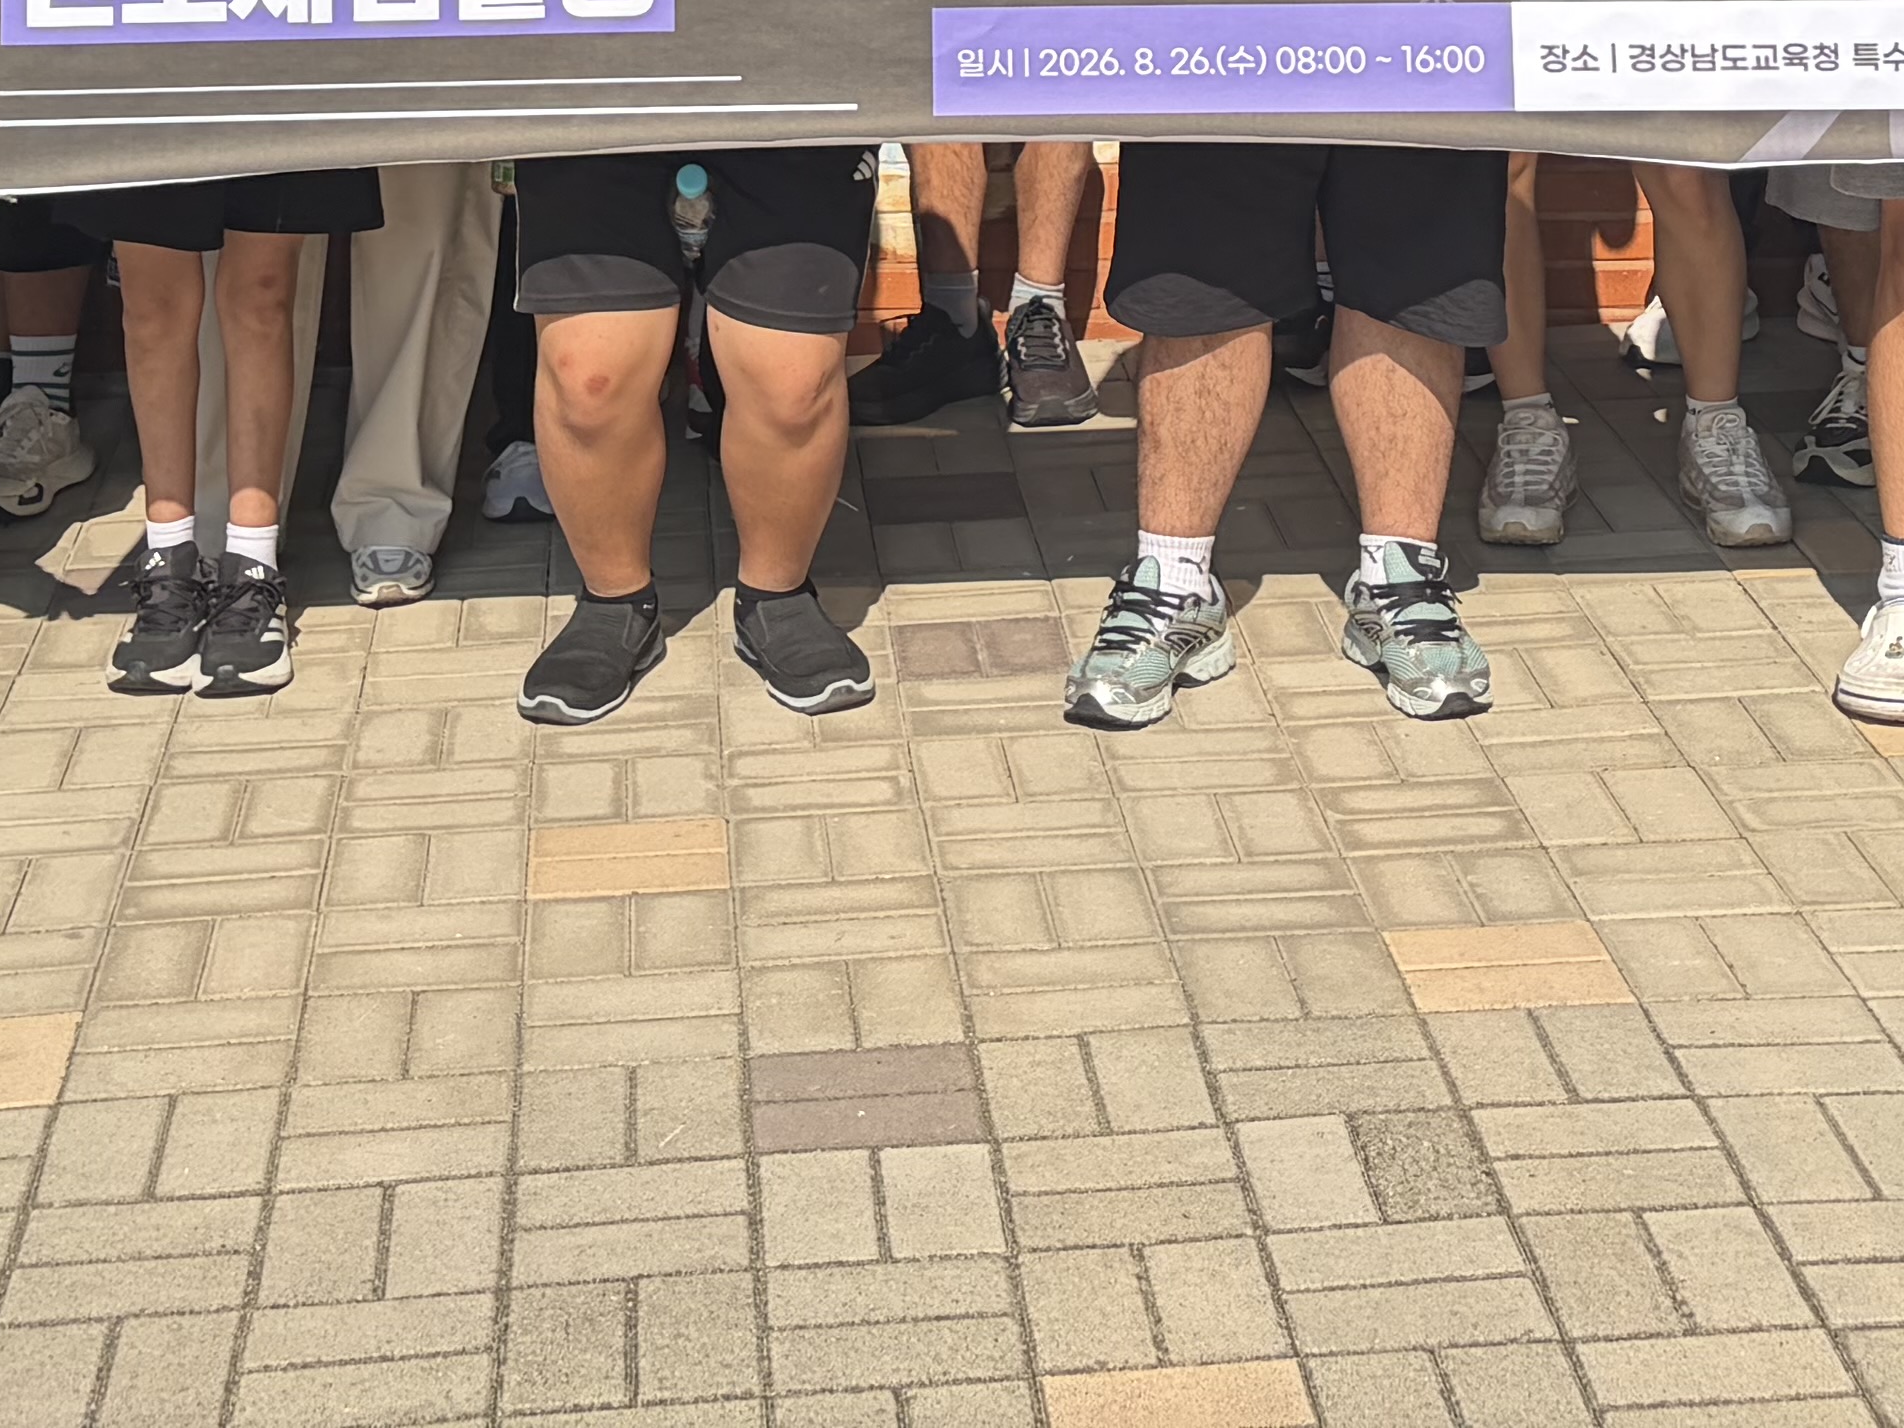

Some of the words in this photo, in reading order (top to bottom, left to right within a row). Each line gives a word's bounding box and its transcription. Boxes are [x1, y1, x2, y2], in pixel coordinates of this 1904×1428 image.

[957, 48, 1014, 78] 일시
[1038, 47, 1127, 77] 2026.
[1134, 47, 1162, 76] 8.
[1170, 45, 1268, 80] 26.(수)
[1275, 45, 1366, 75] 08:00
[1400, 45, 1485, 74] 16:00
[1540, 43, 1601, 74] 장소
[1628, 42, 1840, 74] 경상남도교육청
